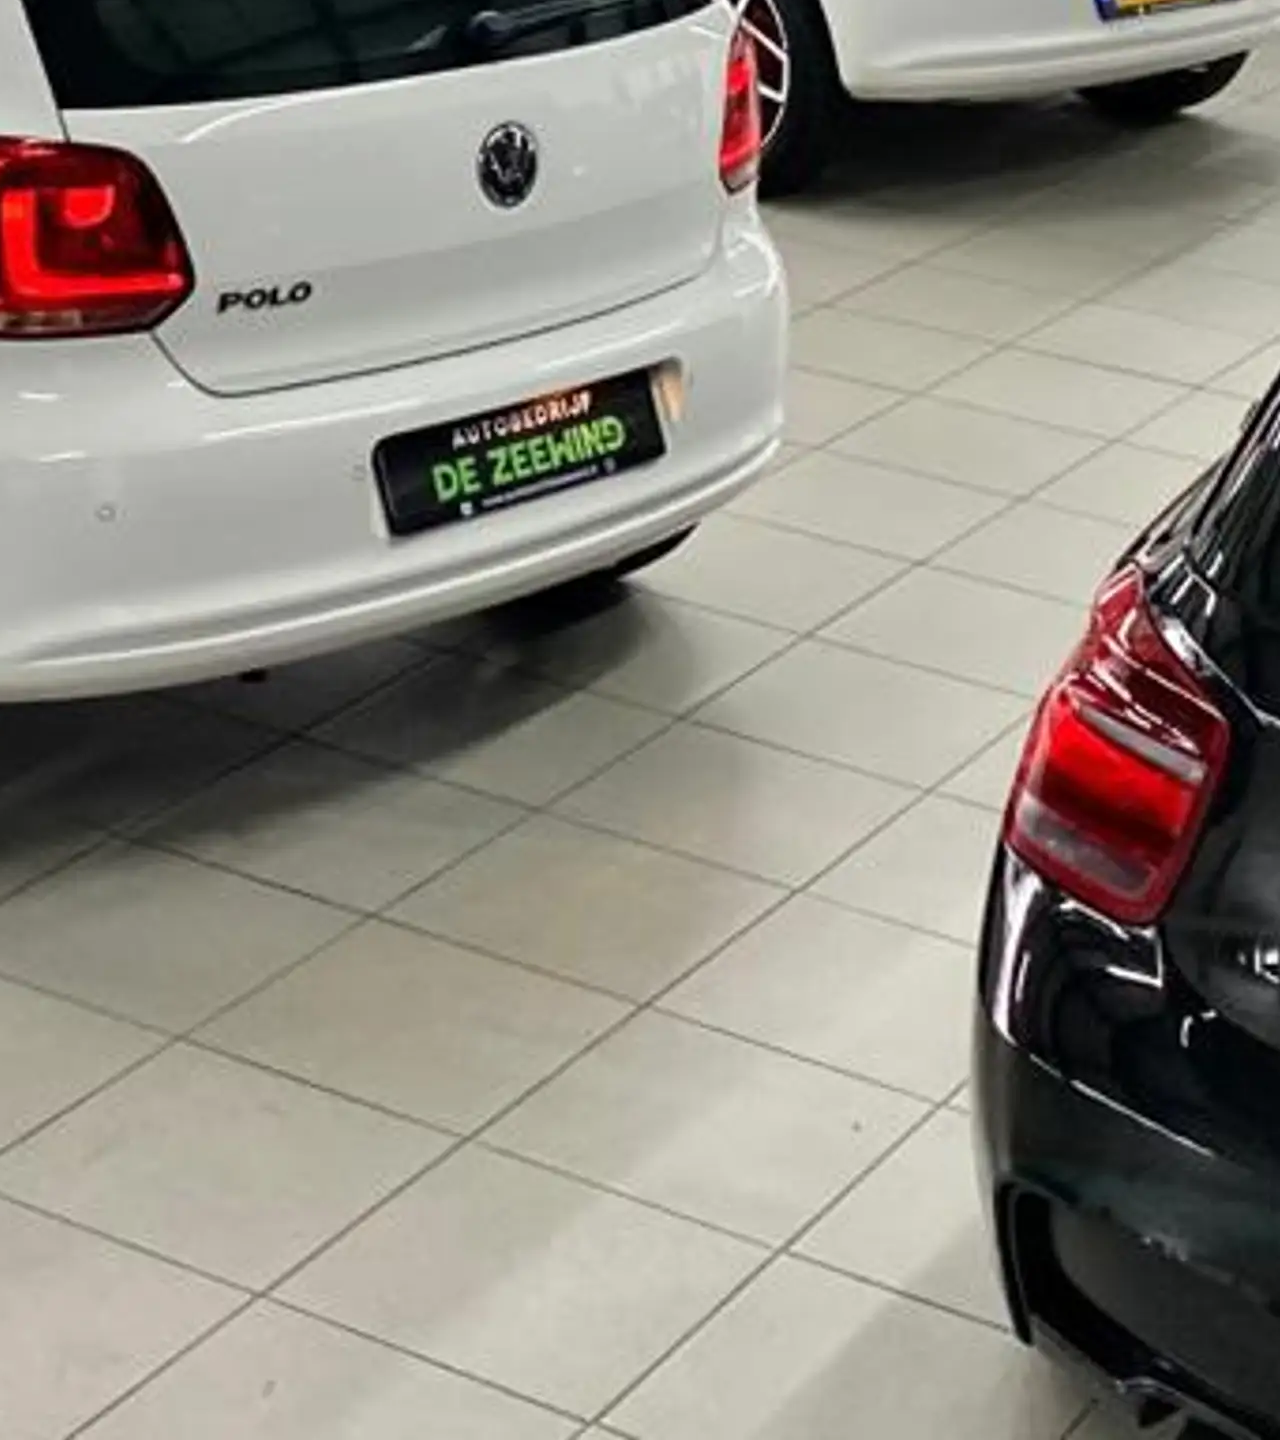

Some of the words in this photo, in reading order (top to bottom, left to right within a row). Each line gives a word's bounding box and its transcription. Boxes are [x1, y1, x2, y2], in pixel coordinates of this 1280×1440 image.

[217, 281, 312, 313] POLO
[451, 390, 593, 450] AUTOBEDRIJF
[431, 456, 481, 503] DE
[486, 415, 626, 487] ZEEWIND
